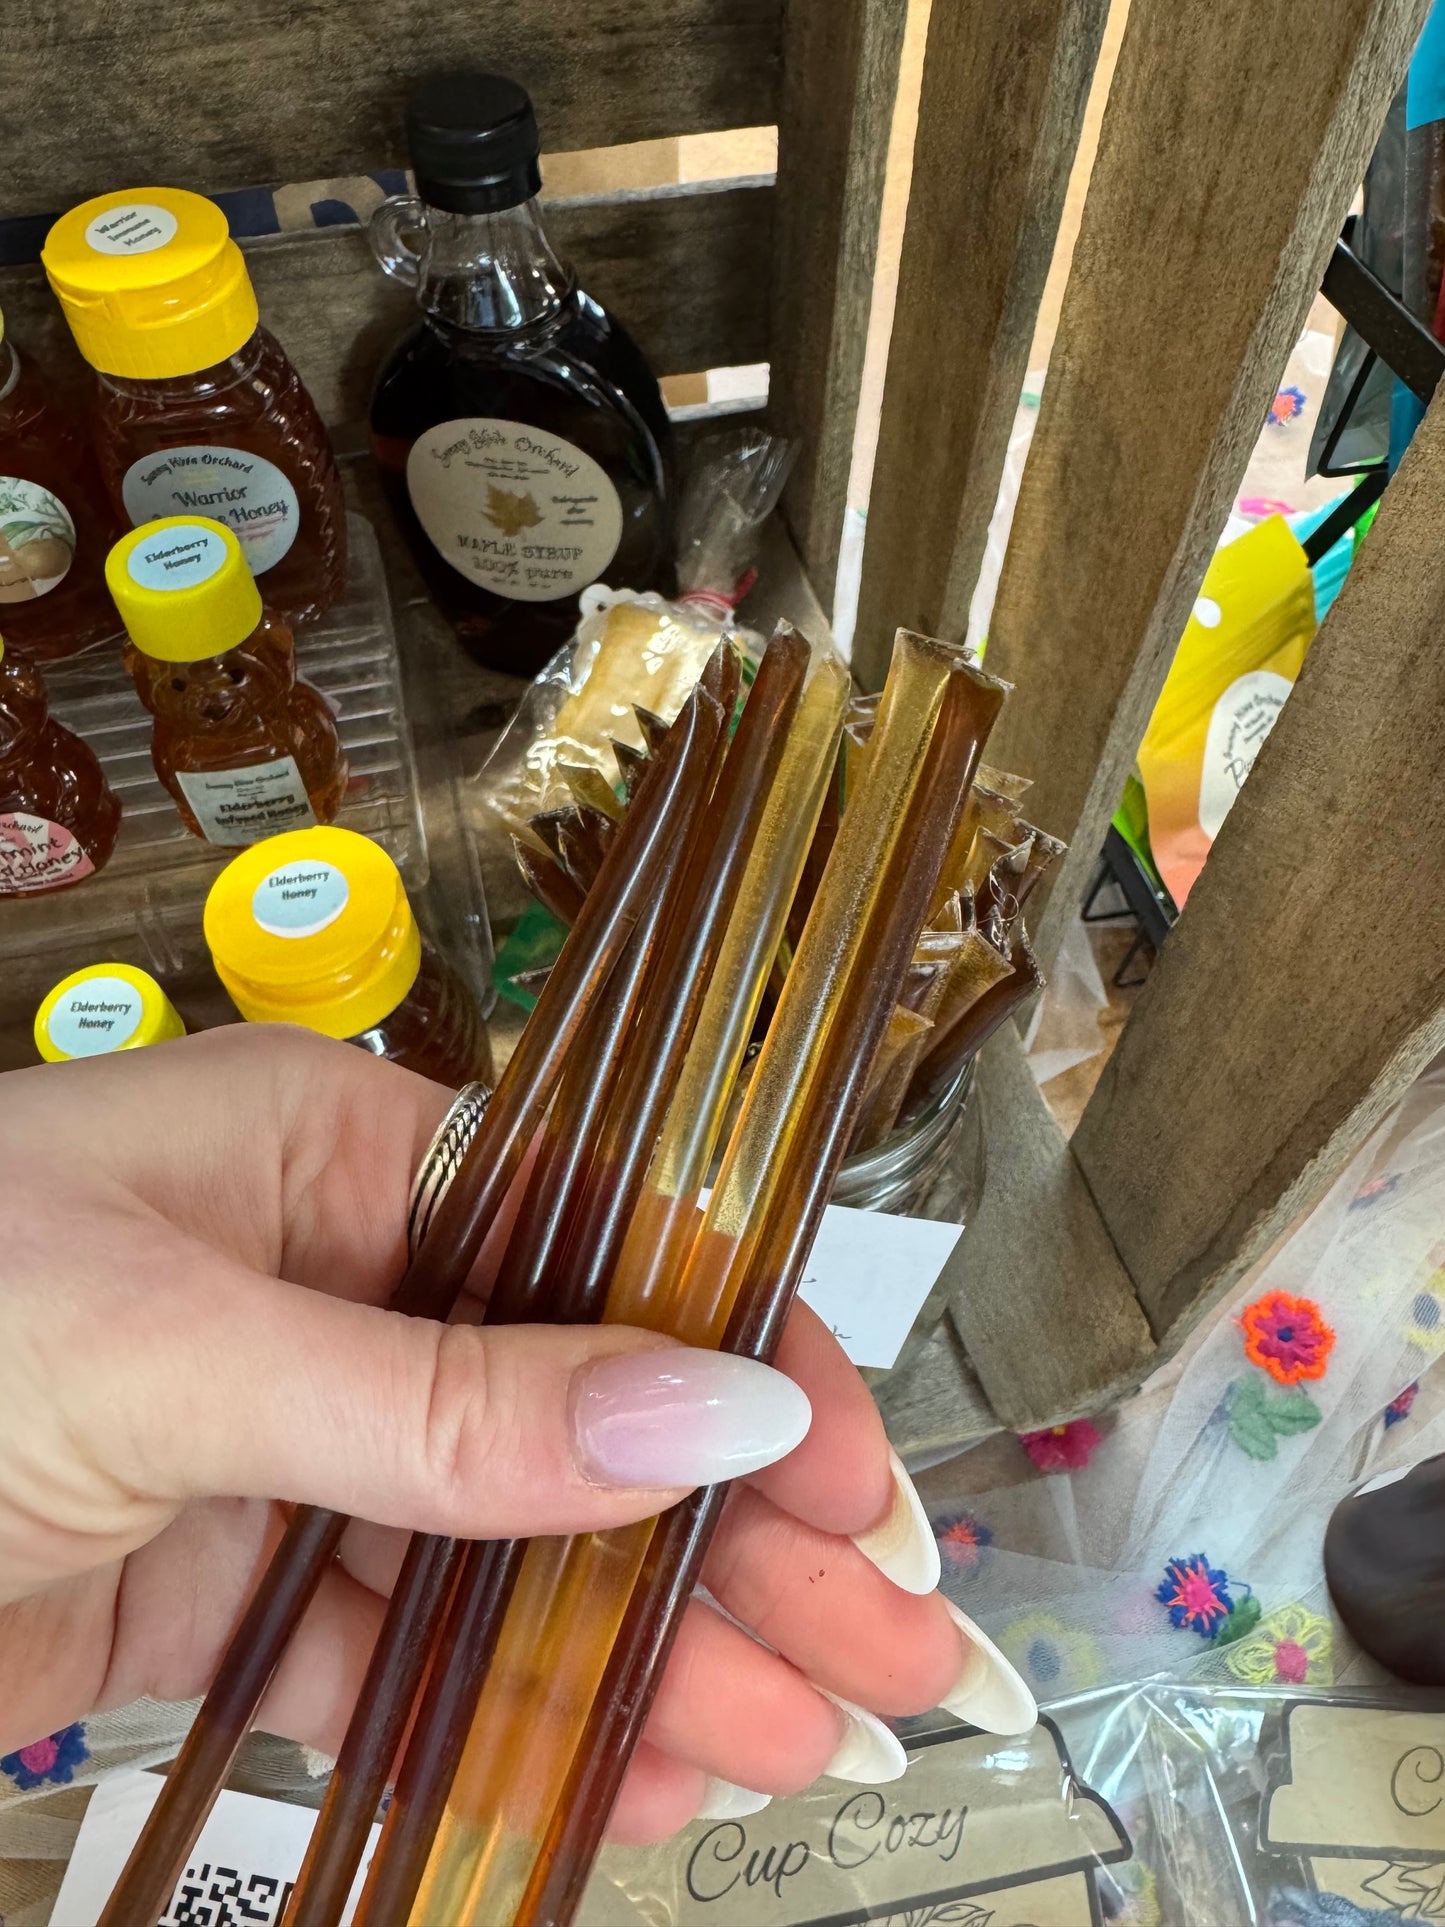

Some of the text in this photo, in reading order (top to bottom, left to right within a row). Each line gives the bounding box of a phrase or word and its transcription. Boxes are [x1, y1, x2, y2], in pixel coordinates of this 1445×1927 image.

[123, 226, 162, 247] Honey
[201, 453, 254, 474] Orchard
[171, 486, 248, 507] Warrior
[144, 538, 208, 564] Elderberry
[163, 553, 202, 571] Honey
[269, 871, 329, 888] Elderberry
[282, 888, 318, 900] Honey
[70, 1000, 132, 1016] Elderberry
[78, 1016, 115, 1032] Honey
[687, 1791, 968, 1902] Cup Cozy
